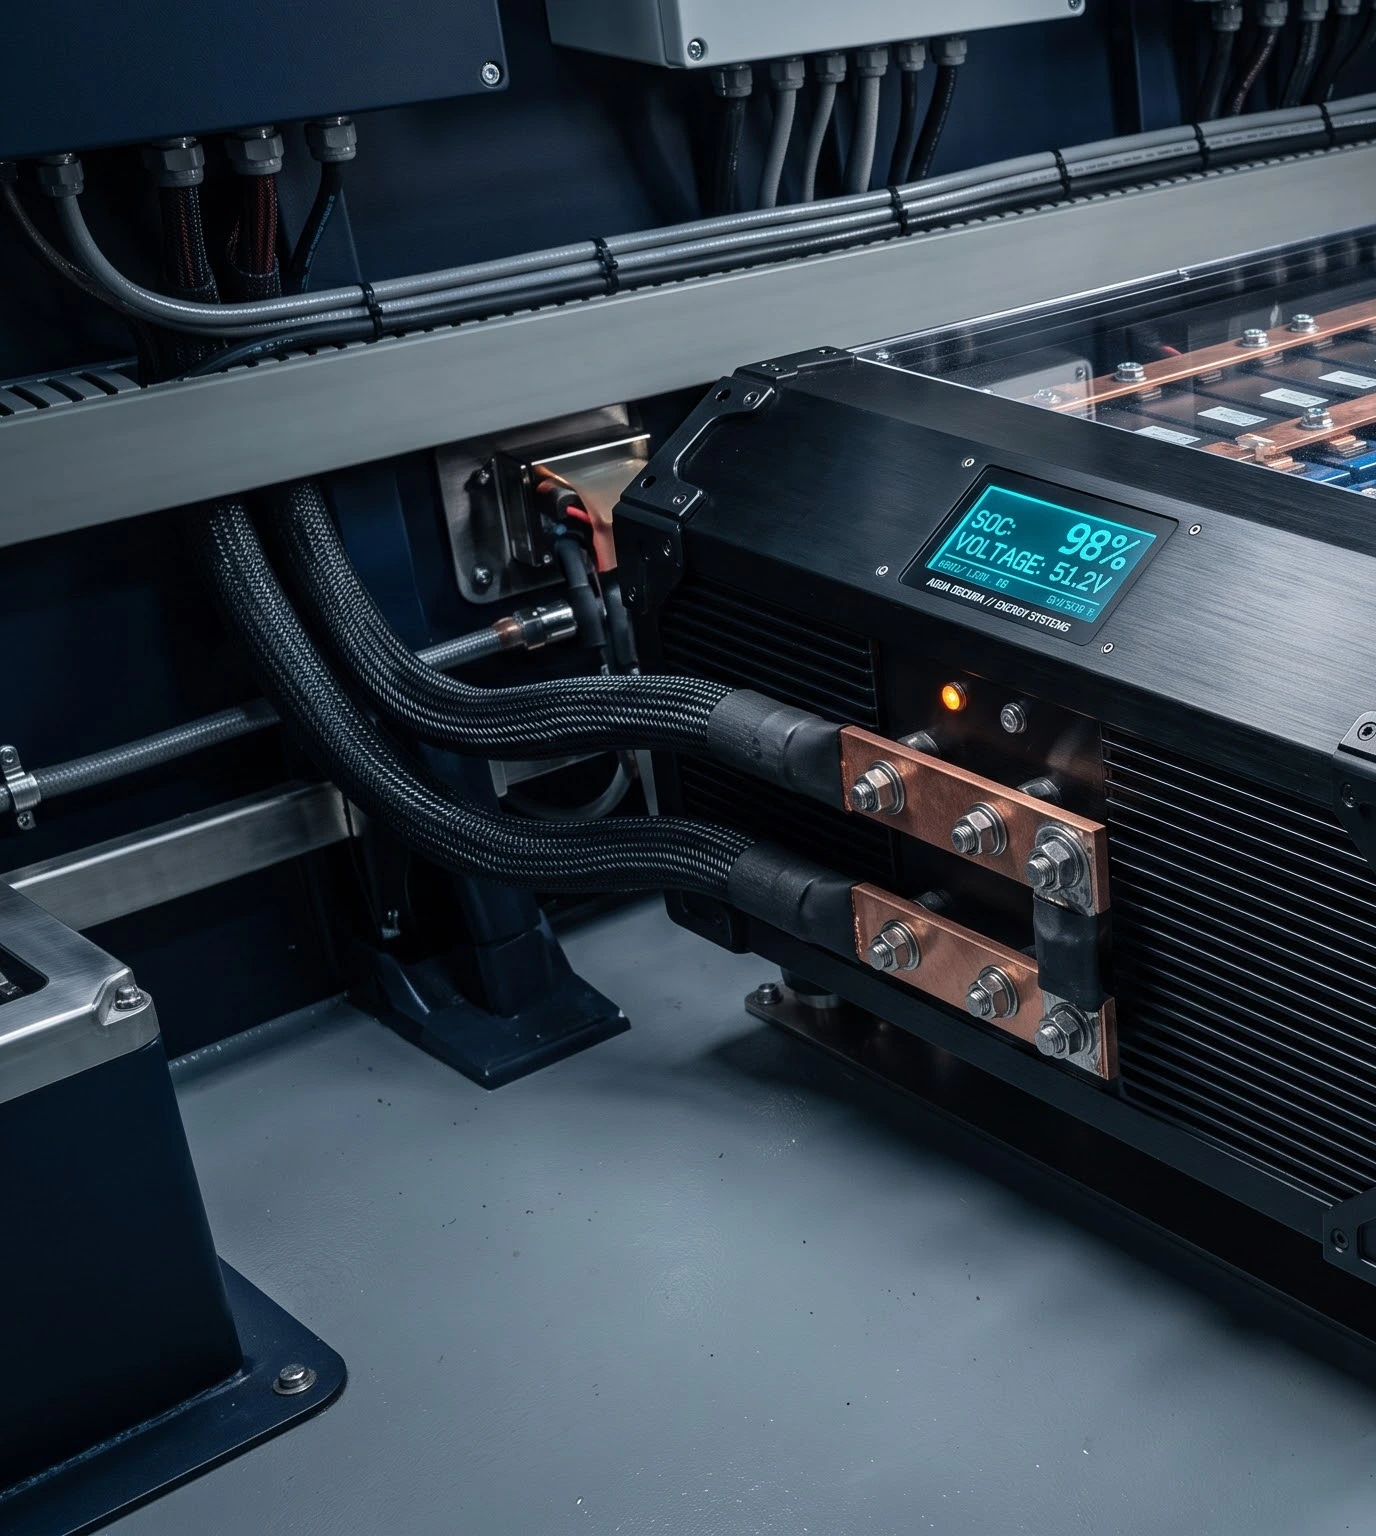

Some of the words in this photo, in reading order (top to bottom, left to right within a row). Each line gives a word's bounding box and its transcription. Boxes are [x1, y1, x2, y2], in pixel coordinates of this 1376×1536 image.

[955, 531, 1046, 575] VOLTAGE:
[1049, 562, 1113, 595] 51.2V
[971, 509, 1017, 536] SOC:
[1058, 523, 1141, 571] 98%
